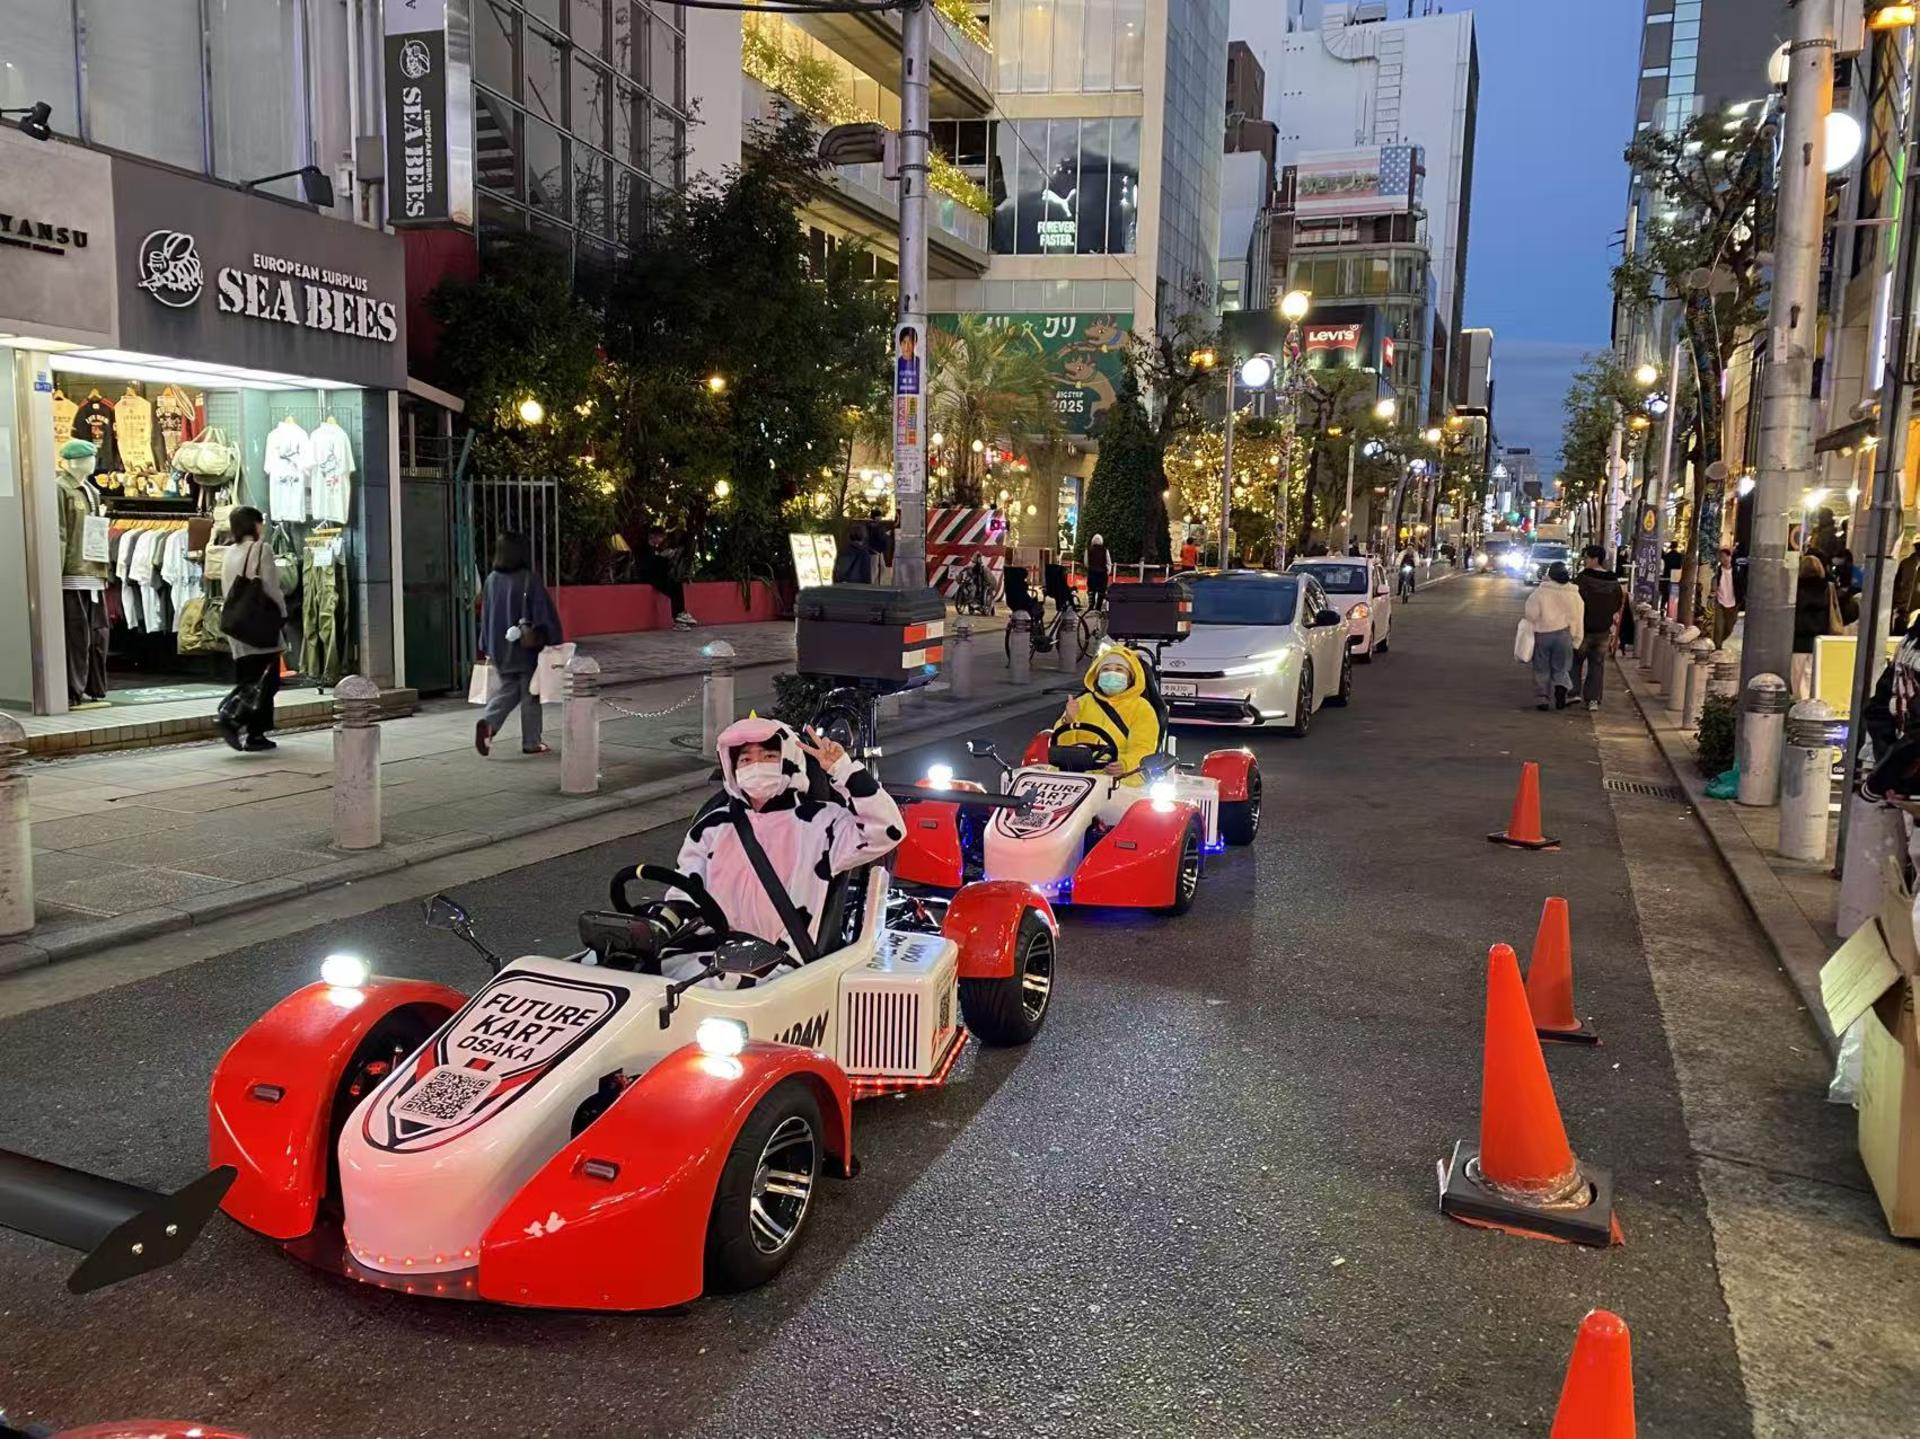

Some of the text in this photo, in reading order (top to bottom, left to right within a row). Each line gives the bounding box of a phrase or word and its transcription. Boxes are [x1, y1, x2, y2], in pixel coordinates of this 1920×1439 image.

[403, 87, 425, 217] SEA BEES
[424, 109, 433, 193] EUROPEAN SURPLUS
[1037, 221, 1075, 234] FOREVER
[1040, 233, 1075, 247] FASTER.
[253, 253, 368, 292] EUROPEAN SURPLUS
[218, 267, 398, 342] SEA BEES
[1042, 316, 1077, 338] クリ
[1050, 400, 1084, 413] 2025
[1021, 781, 1085, 793] FUTURE
[1036, 791, 1072, 800] ART
[481, 993, 598, 1027] FUTURE
[470, 1014, 566, 1045] KART
[774, 1009, 830, 1048] PAN
[457, 1036, 535, 1062] OSAKA
